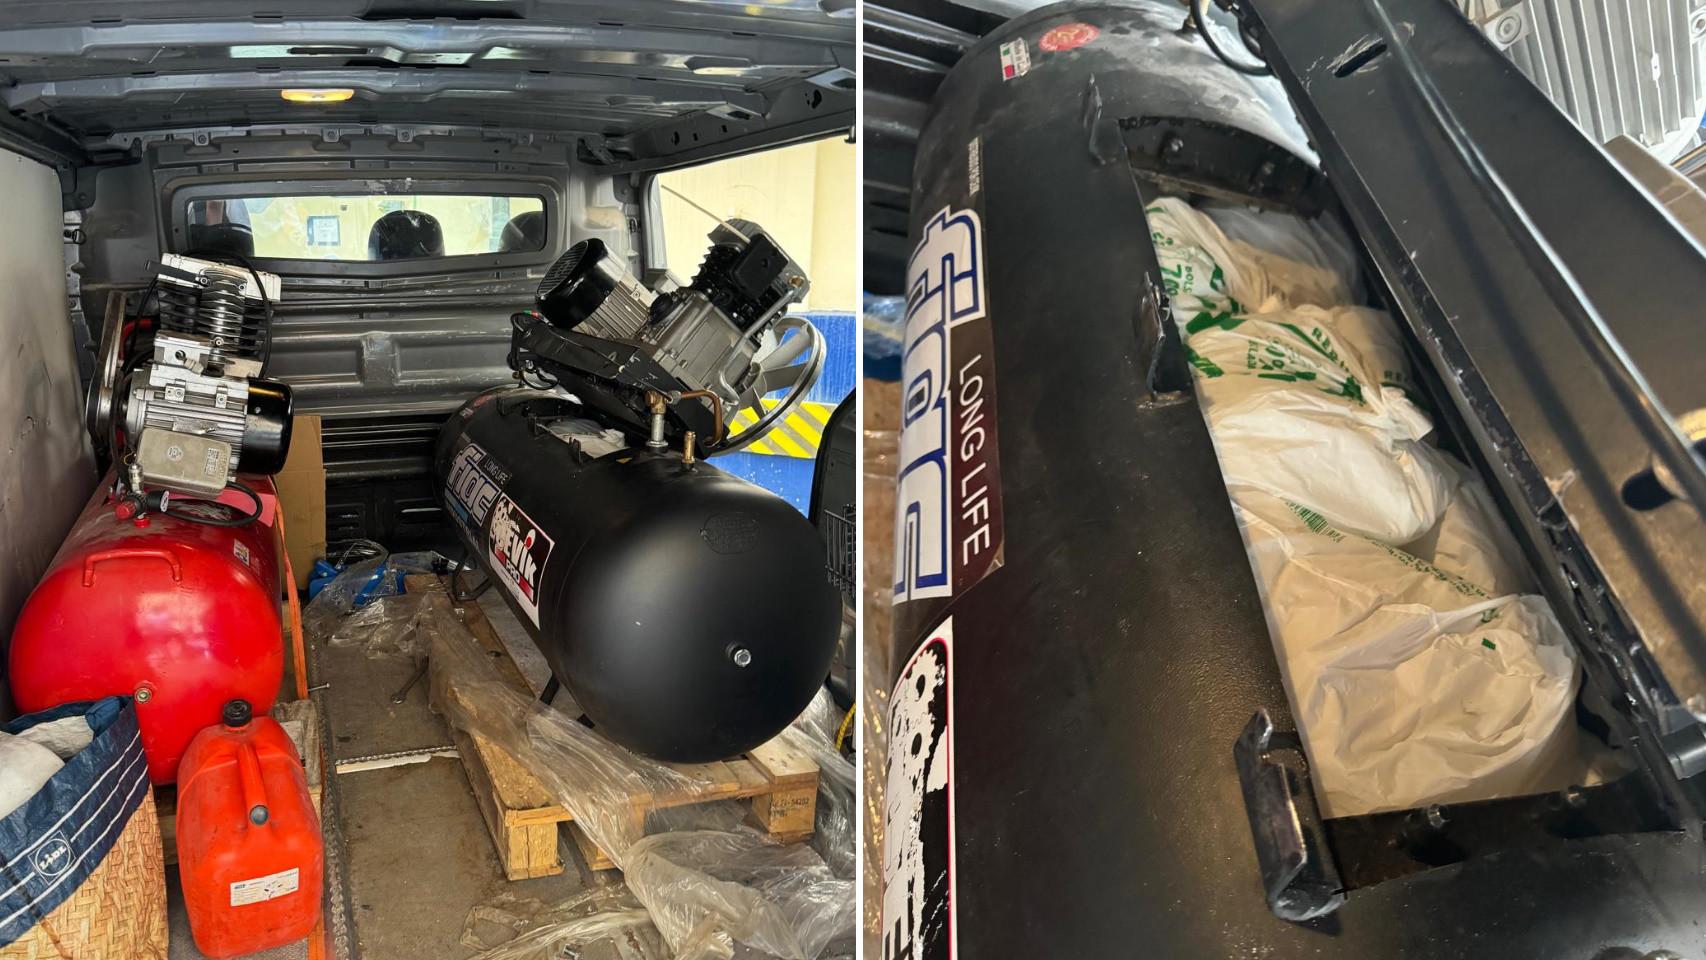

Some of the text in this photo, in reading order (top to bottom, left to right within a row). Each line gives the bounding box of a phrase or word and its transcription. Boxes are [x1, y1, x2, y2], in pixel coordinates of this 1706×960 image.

[484, 456, 499, 478] LONG
[960, 354, 991, 567] LONG LIFE
